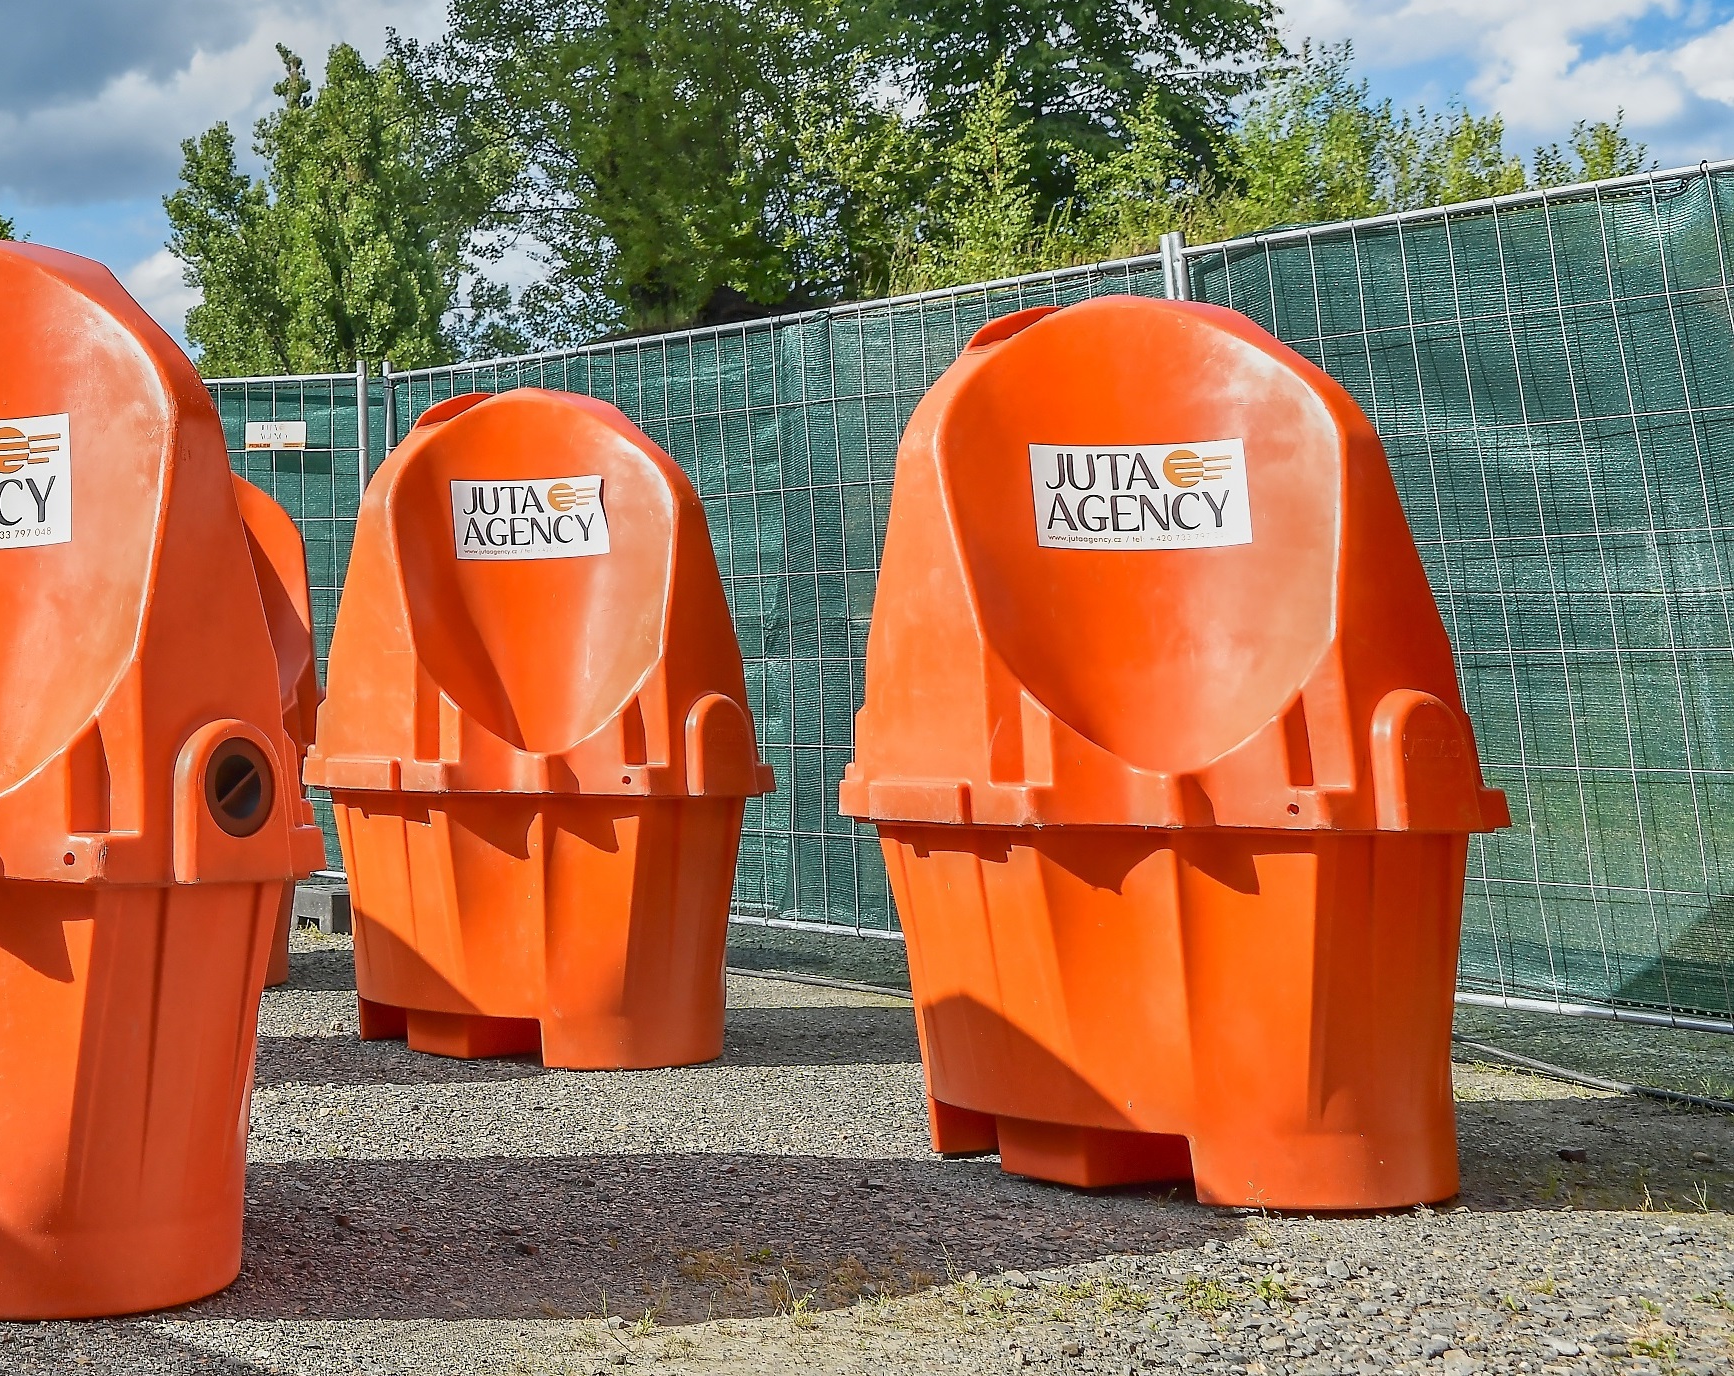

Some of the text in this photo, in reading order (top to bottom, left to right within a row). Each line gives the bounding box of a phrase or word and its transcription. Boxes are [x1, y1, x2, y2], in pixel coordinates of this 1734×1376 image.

[1045, 451, 1161, 491] JUTA
[462, 485, 545, 515] JUTA
[1046, 488, 1230, 533] AGENCY
[14, 528, 32, 539] 797
[34, 526, 52, 537] 048
[463, 512, 595, 546] AGENCY
[1047, 534, 1122, 544] www.jutaagency.cz
[463, 548, 518, 556] wwwjutaagencycz
